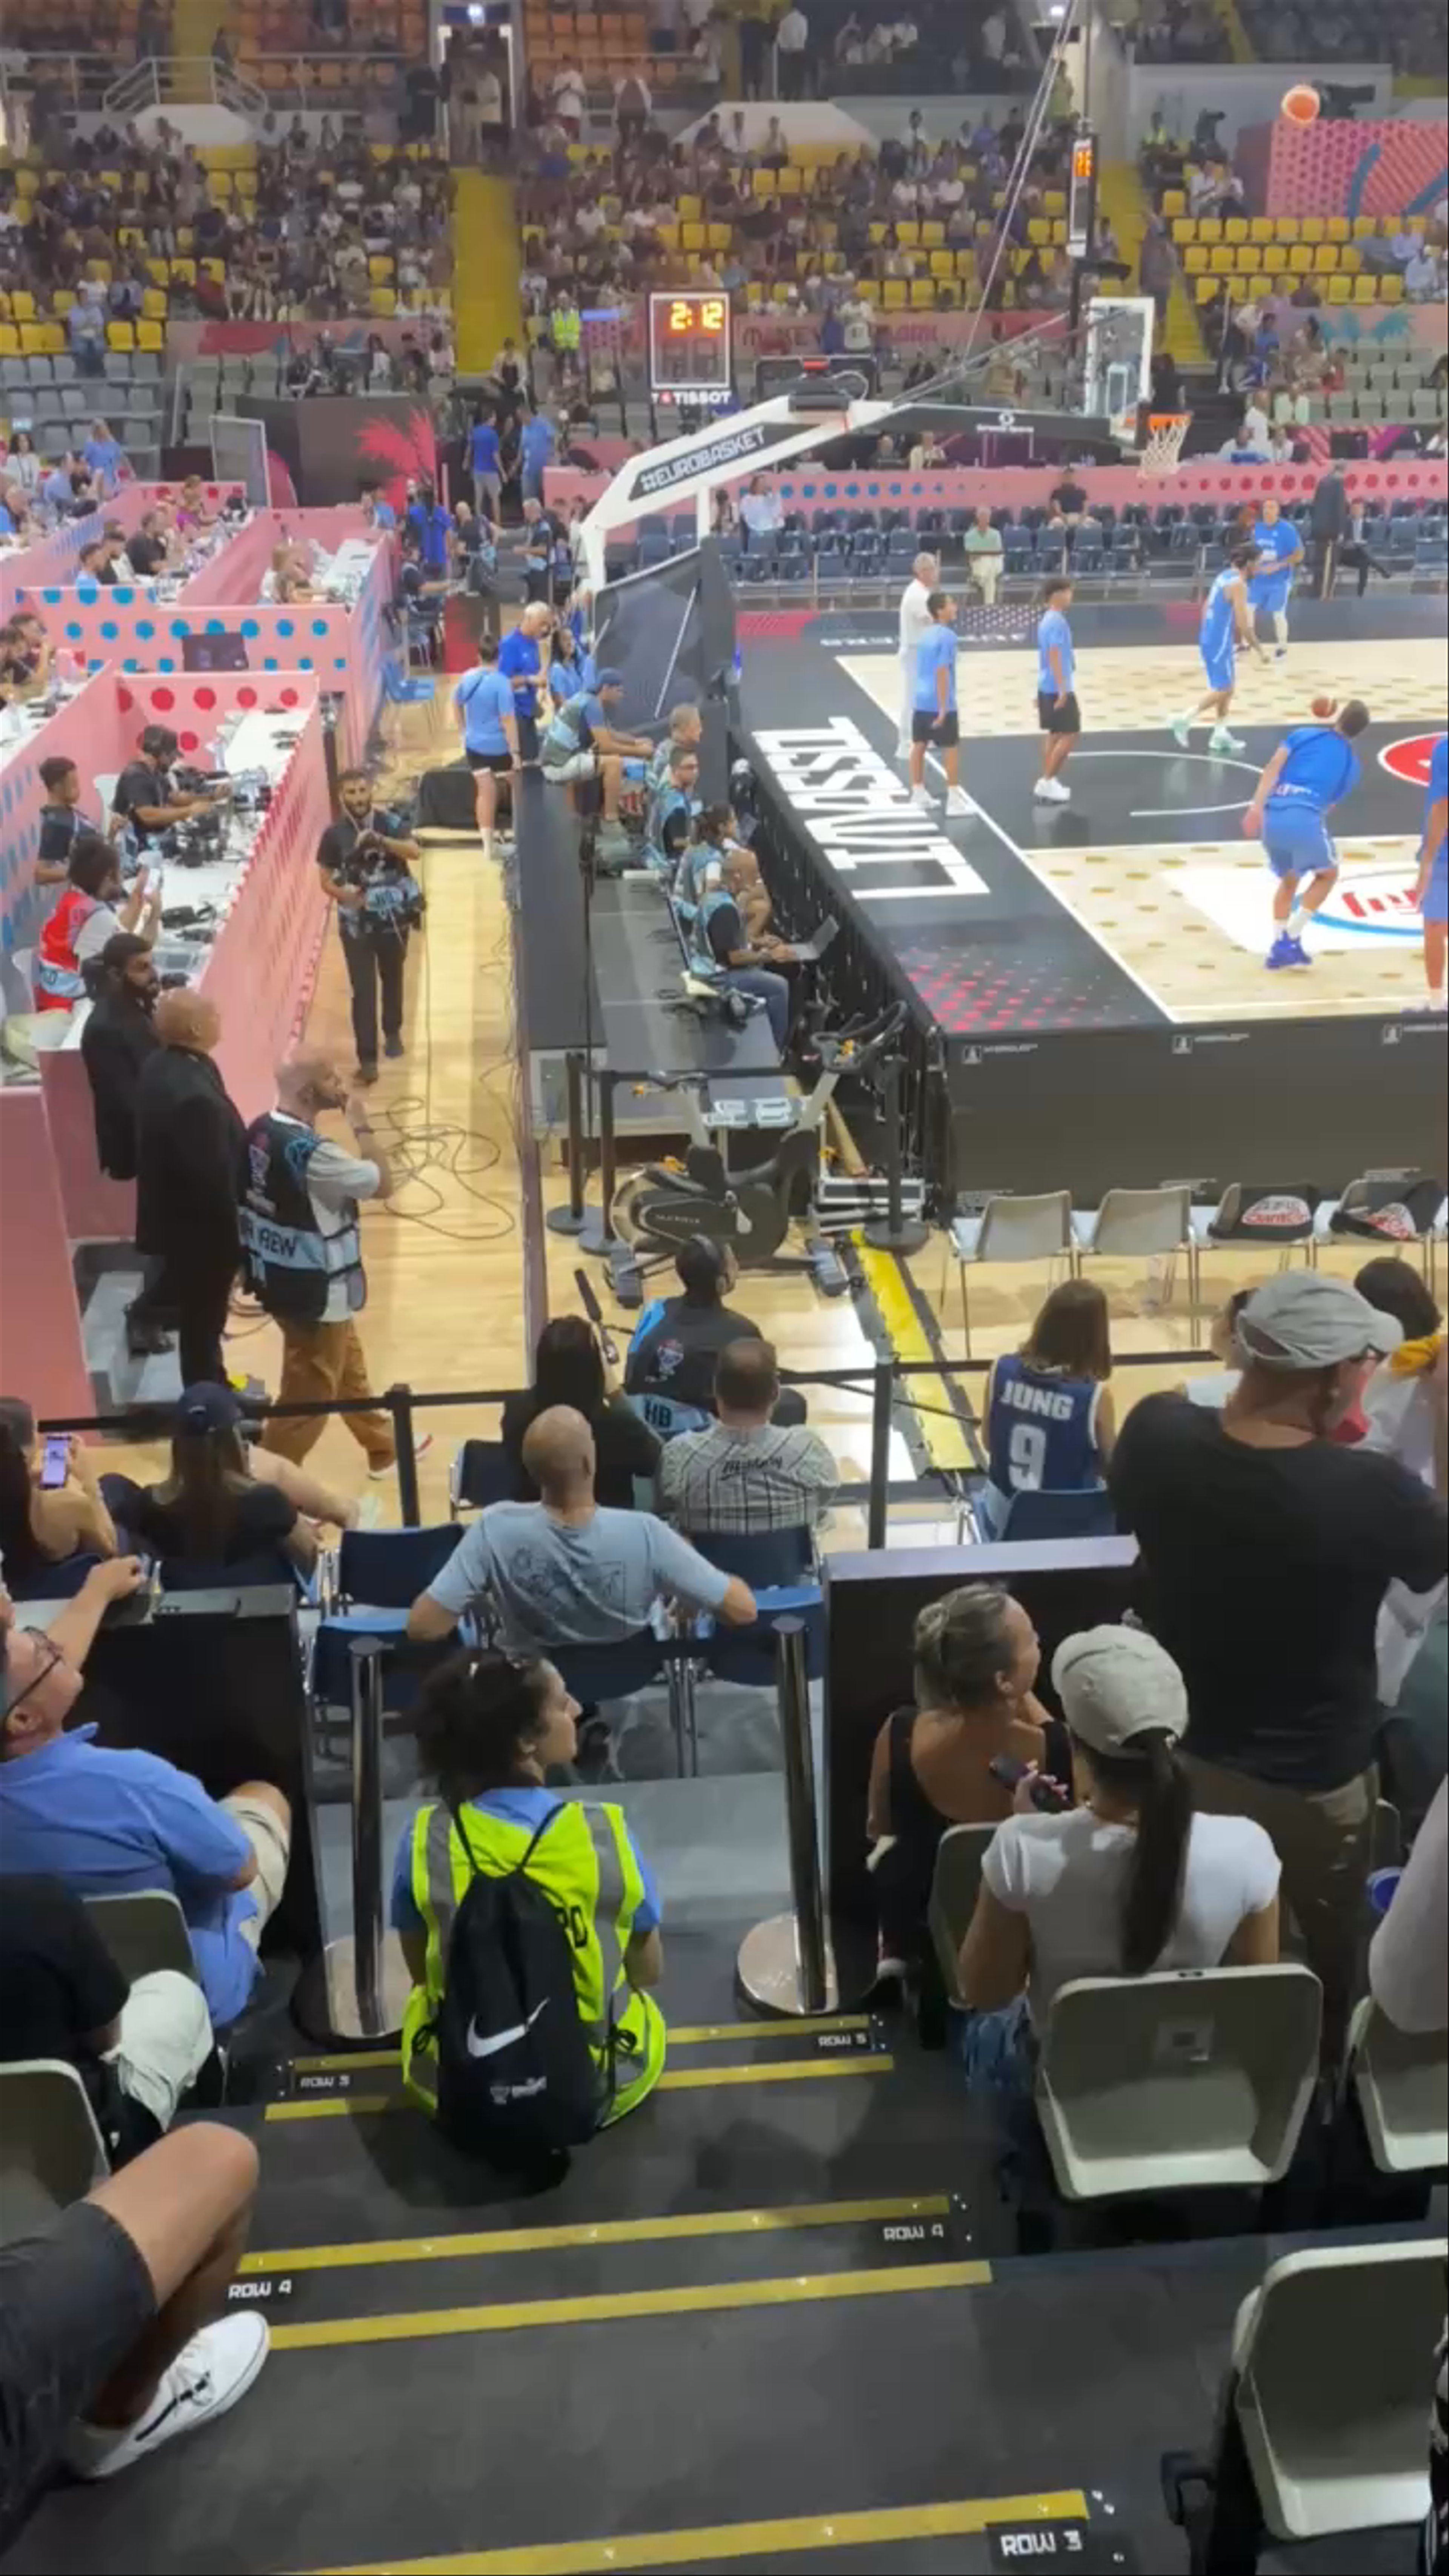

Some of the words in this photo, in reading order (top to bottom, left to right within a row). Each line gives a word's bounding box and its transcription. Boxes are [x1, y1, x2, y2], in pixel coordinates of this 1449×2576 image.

[670, 301, 724, 330] 2:12
[674, 391, 732, 405] TISSOT
[640, 425, 766, 491] #EUROBASKET
[999, 1380, 1075, 1421] JUNG
[1008, 1422, 1047, 1491] 9
[818, 2035, 851, 2047] ROW
[883, 2225, 925, 2241] ROW
[228, 2281, 271, 2300] ROW
[278, 2279, 292, 2295] 4
[1000, 2531, 1057, 2558] ROW
[1063, 2529, 1083, 2551] 3
